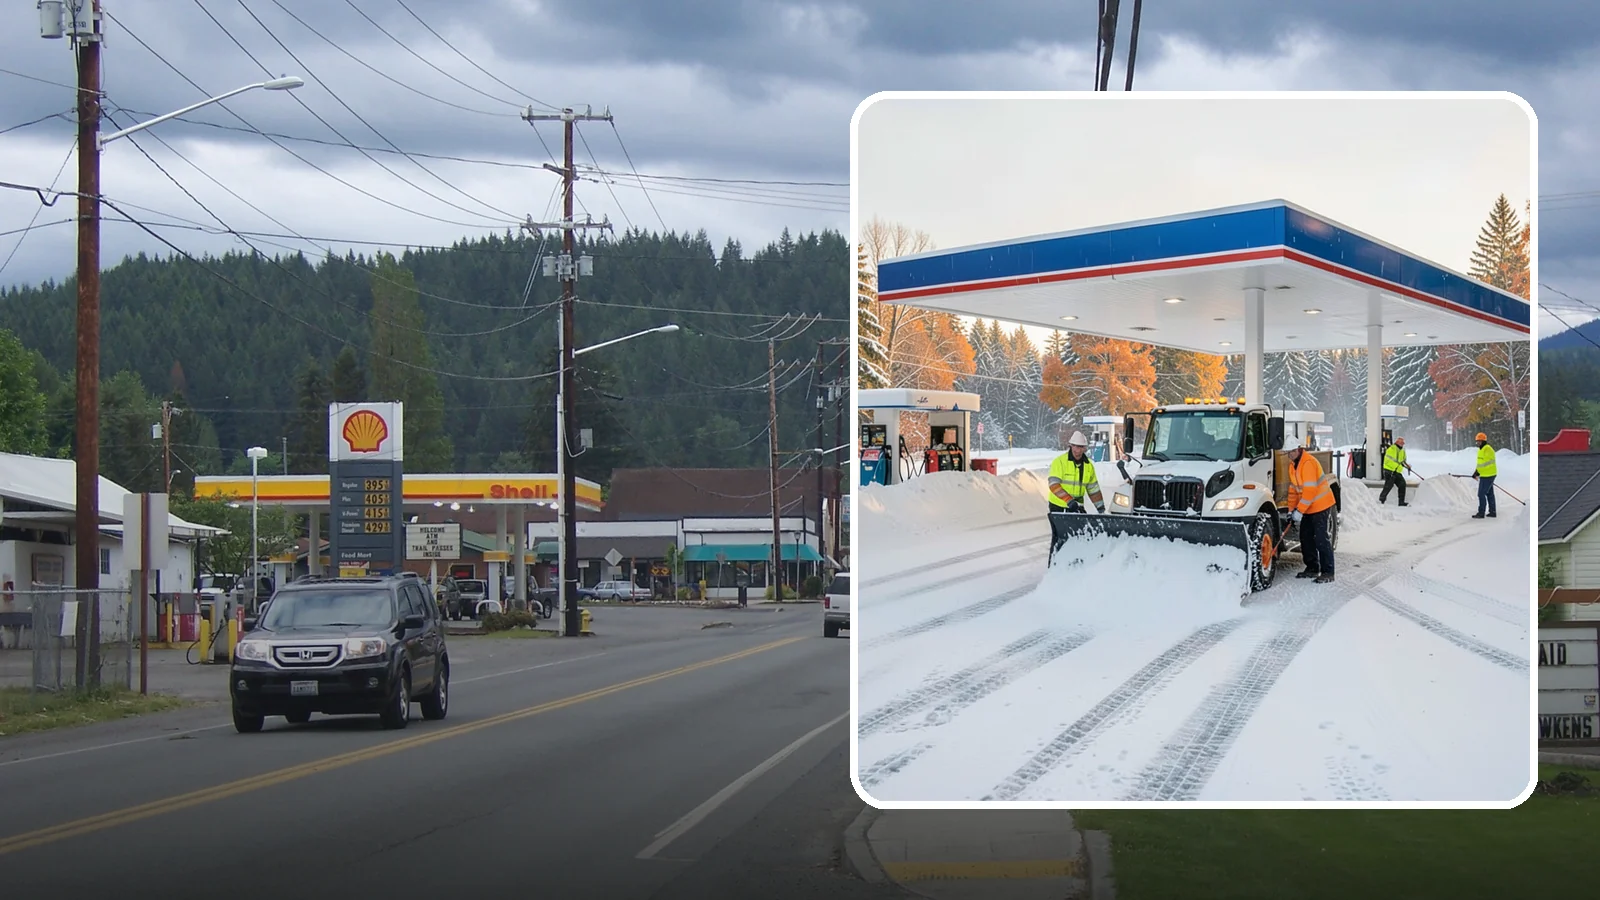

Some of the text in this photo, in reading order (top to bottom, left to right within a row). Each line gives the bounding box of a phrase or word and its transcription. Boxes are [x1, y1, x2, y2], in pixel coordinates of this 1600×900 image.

[366, 480, 383, 490] 395
[490, 484, 547, 499] Shell
[366, 494, 383, 504] 405
[366, 508, 383, 518] 415
[366, 522, 383, 532] 429
